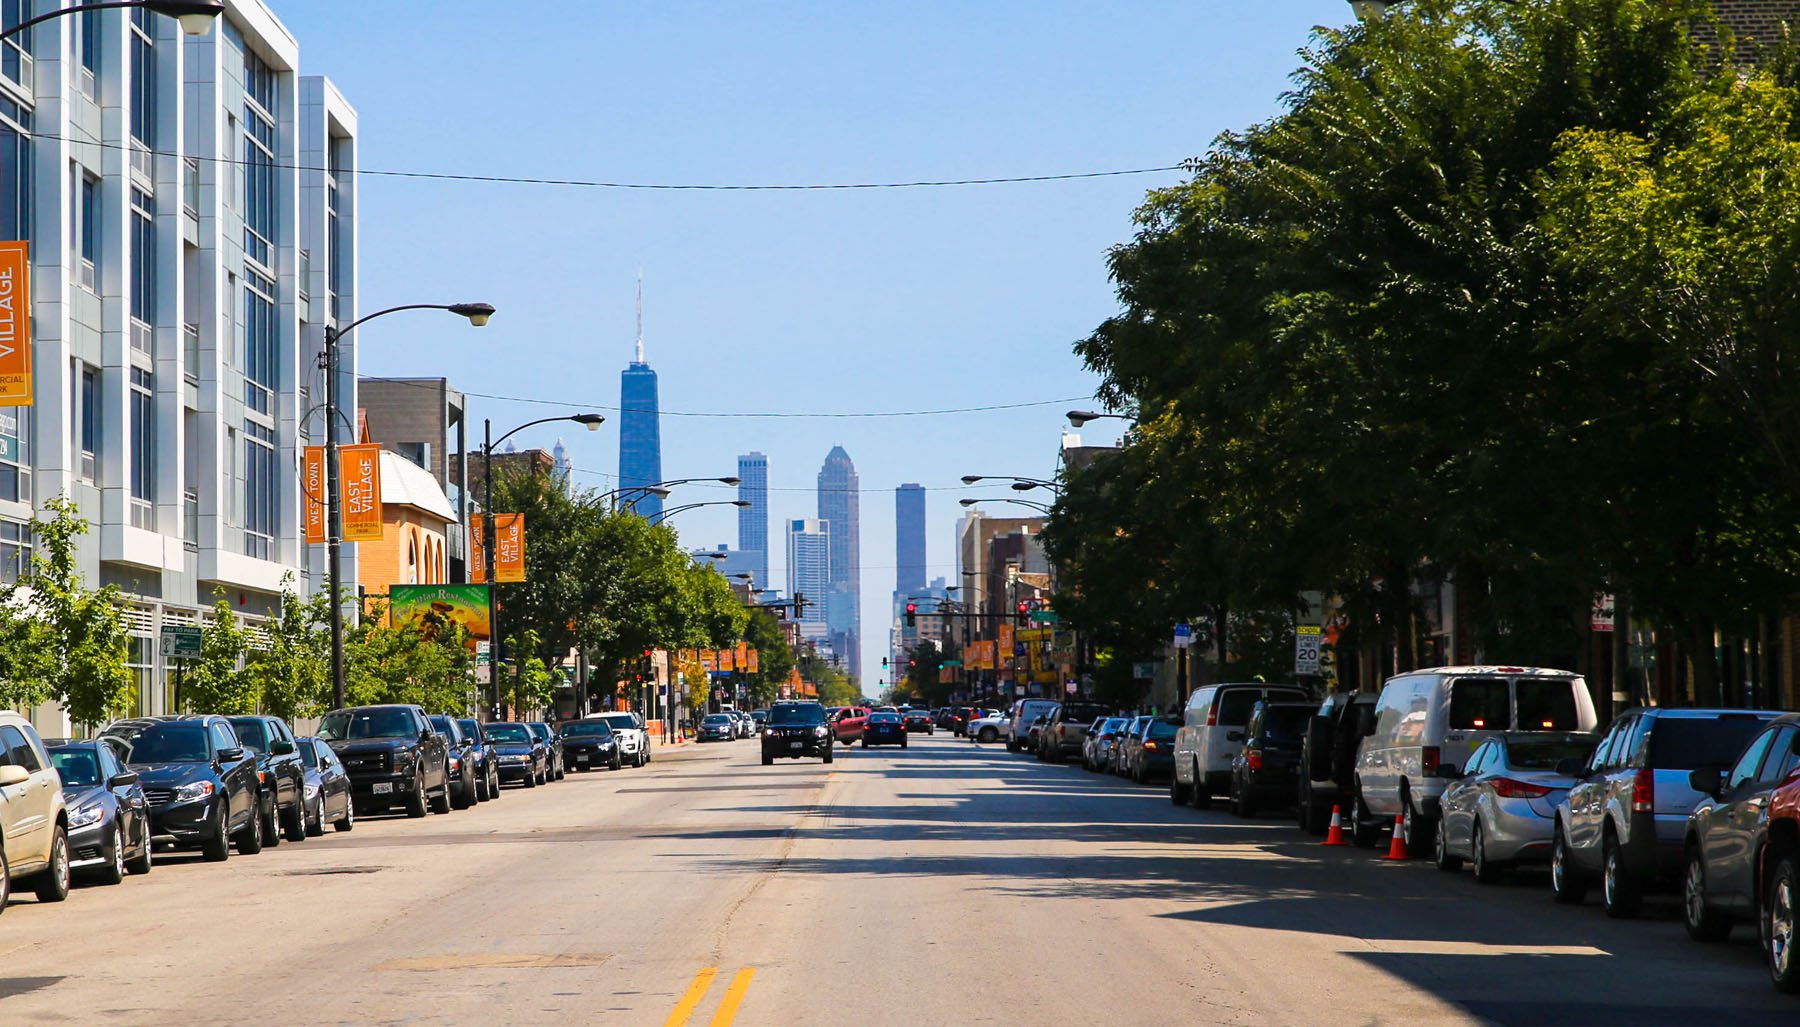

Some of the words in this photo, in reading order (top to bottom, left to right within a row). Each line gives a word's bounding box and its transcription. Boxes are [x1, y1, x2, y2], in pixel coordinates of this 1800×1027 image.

[0, 266, 16, 358] VILLAGE
[309, 462, 319, 493] TOWN
[360, 458, 374, 513] VILLAGE
[310, 498, 319, 526] WEST
[348, 480, 361, 513] EAST
[501, 539, 510, 563] EAST
[510, 525, 519, 563] VILLAGE
[438, 588, 484, 620] Restaurant
[1298, 648, 1317, 660] 20
